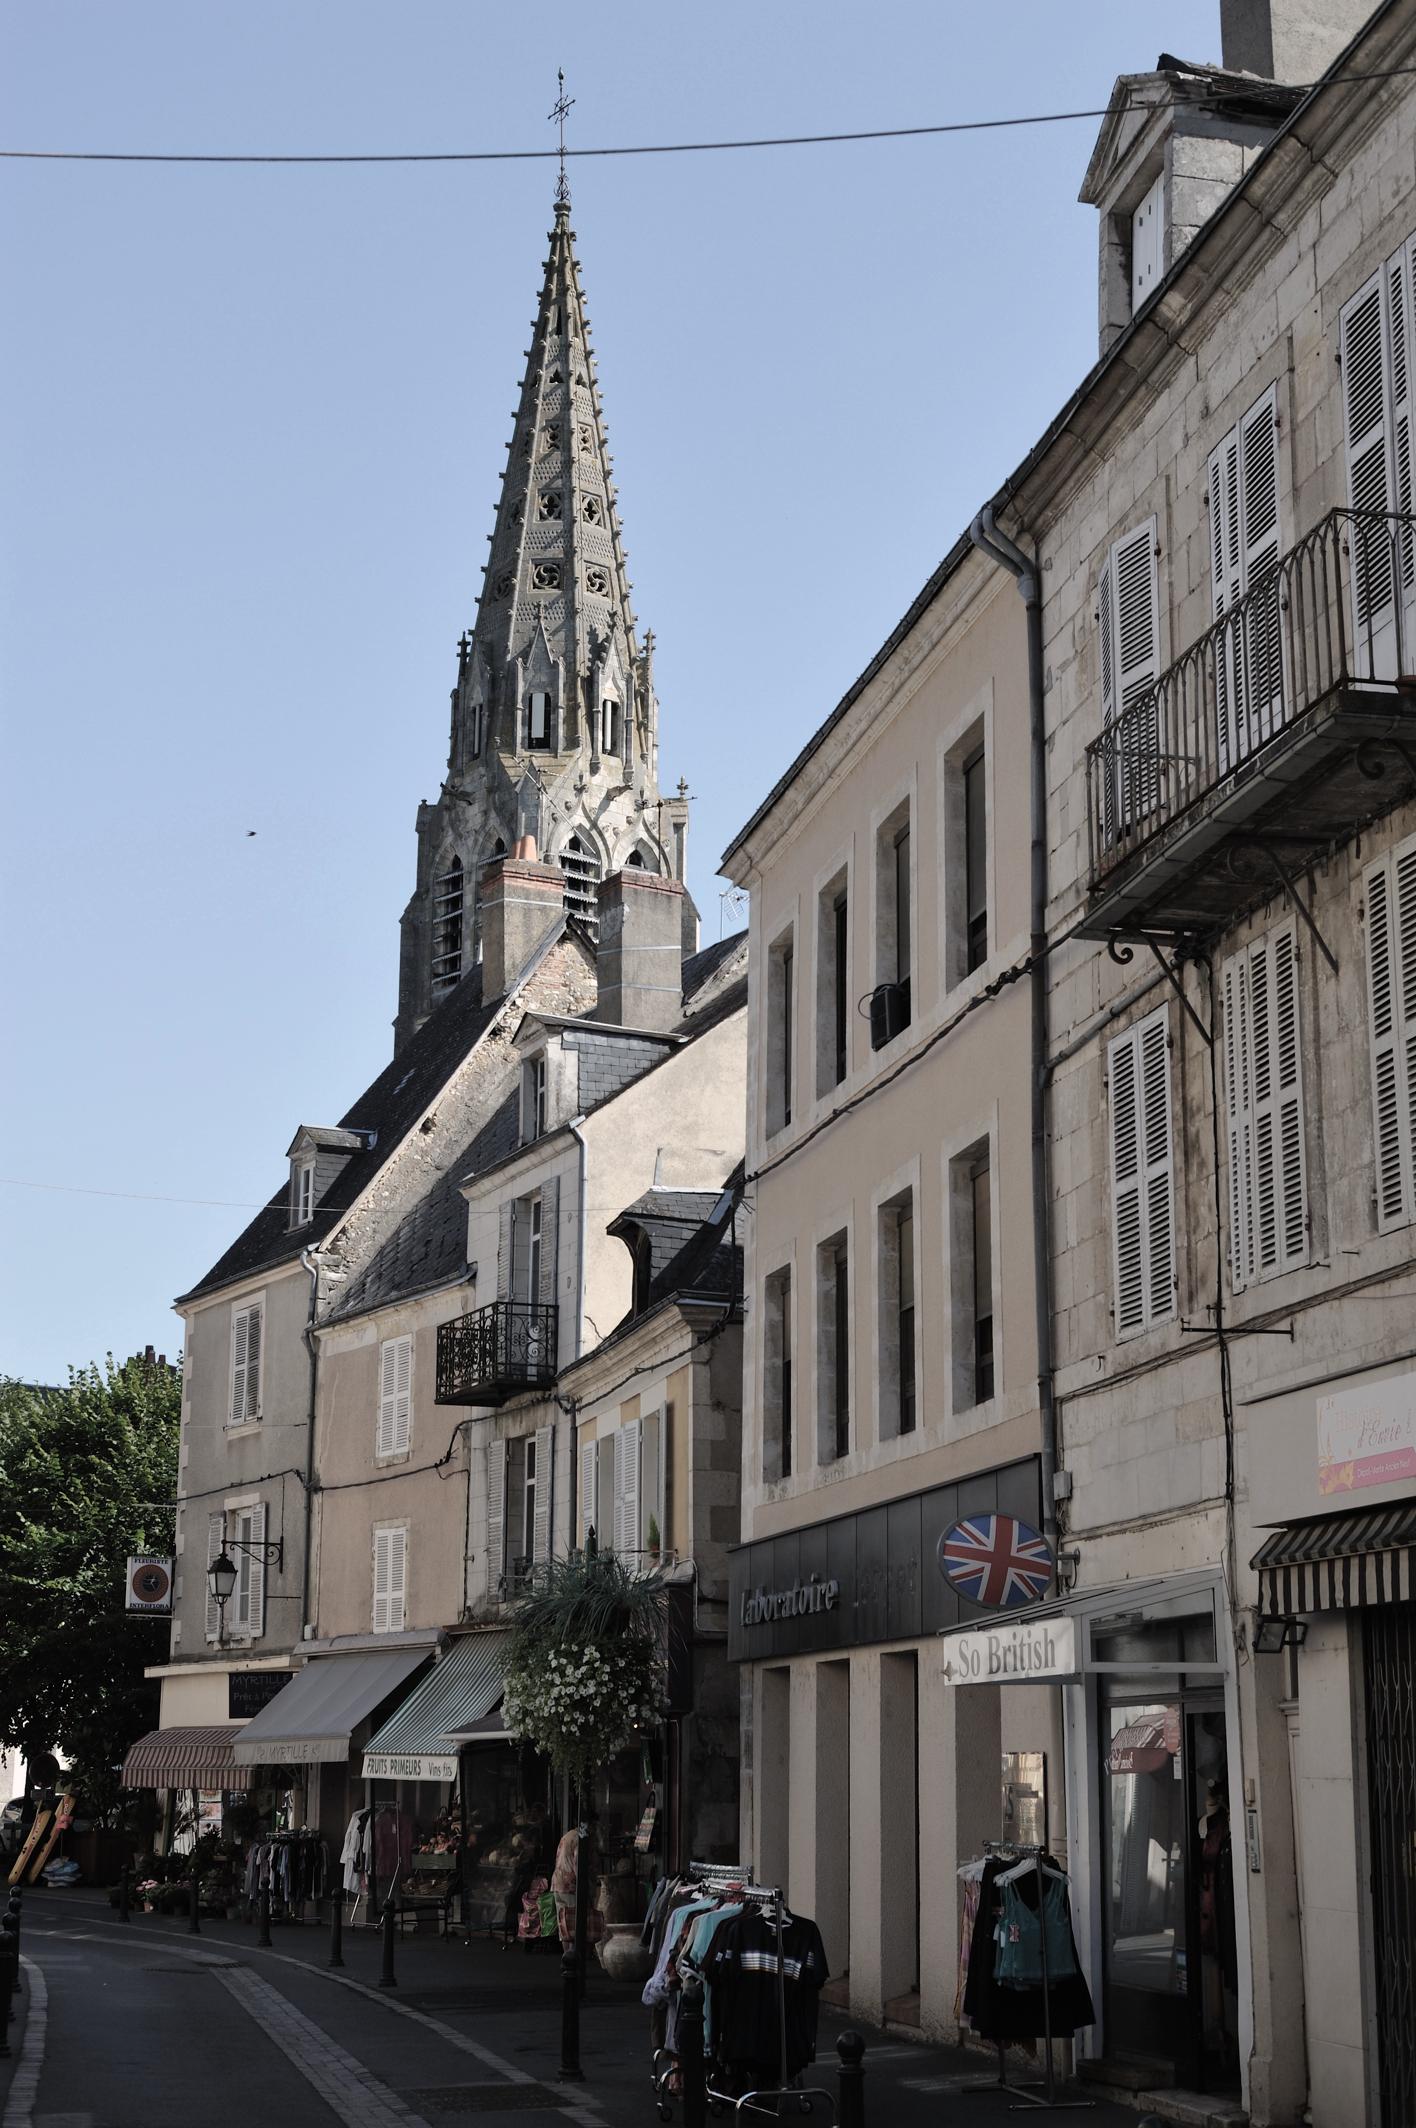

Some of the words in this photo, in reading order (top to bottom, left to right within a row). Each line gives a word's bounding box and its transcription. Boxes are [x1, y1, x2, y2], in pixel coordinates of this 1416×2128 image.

[958, 1639, 981, 1679] So
[987, 1628, 1057, 1675] British
[268, 1743, 308, 1760] MYRTILLE
[366, 1757, 388, 1774] FRUITS
[390, 1758, 422, 1776] PRIMEURS
[428, 1762, 441, 1777] Vins
